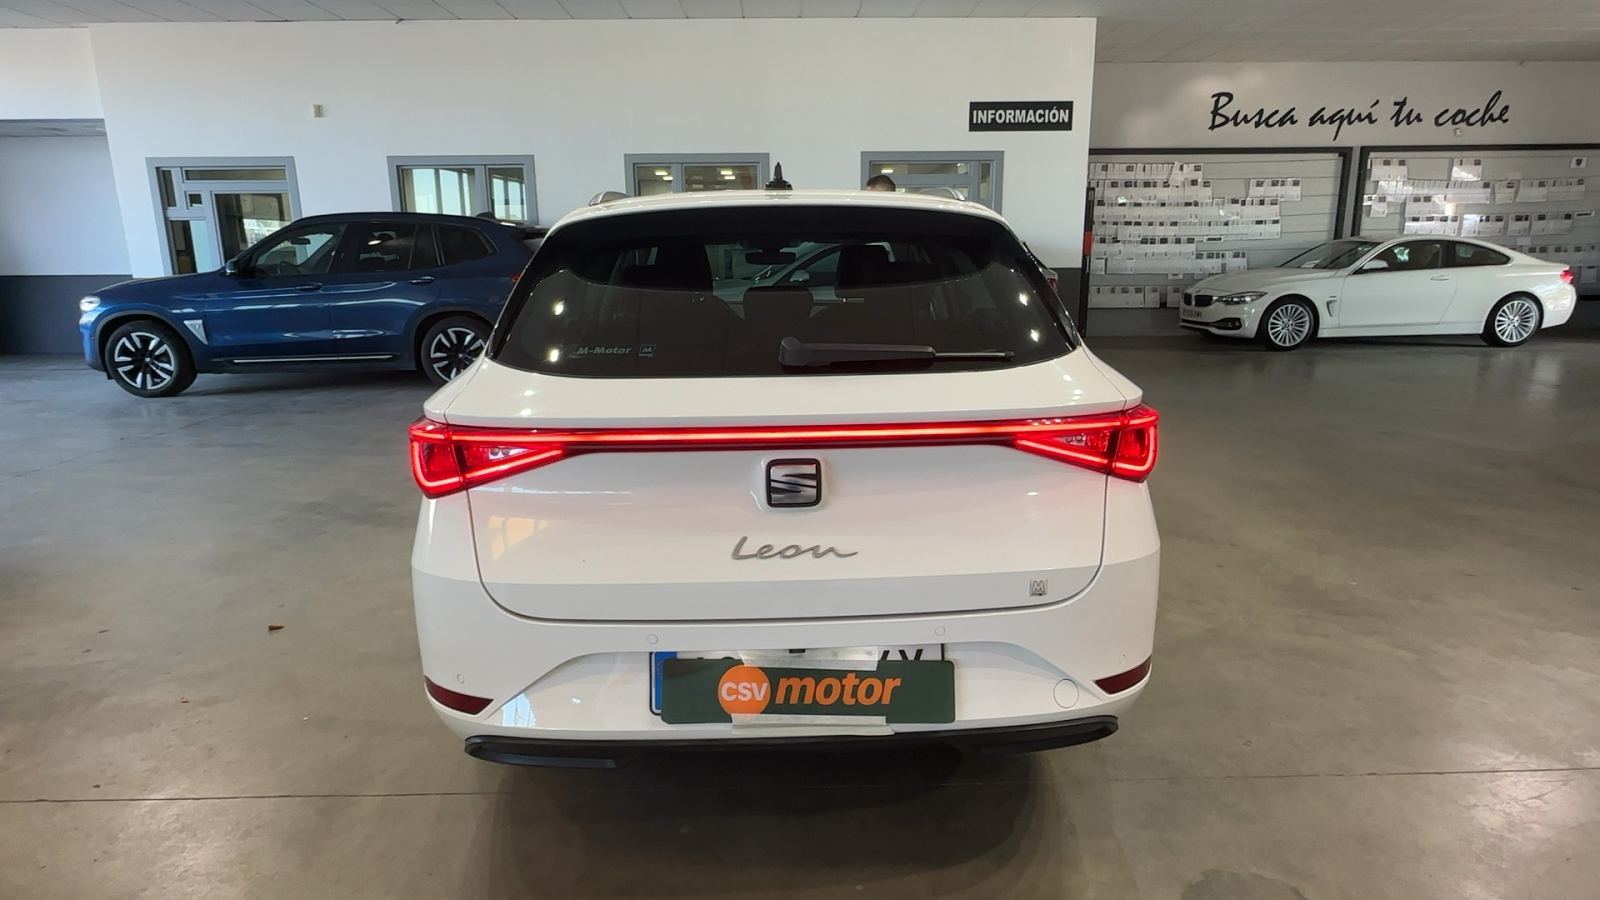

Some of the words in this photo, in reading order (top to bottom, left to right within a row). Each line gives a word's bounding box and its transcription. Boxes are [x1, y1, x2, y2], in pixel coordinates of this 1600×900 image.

[973, 106, 1069, 124] INFORMACIÓN
[1208, 91, 1298, 131] Busca
[1308, 99, 1379, 141] aquí
[1390, 96, 1423, 127] tu
[1434, 90, 1510, 127] coche
[577, 346, 632, 354] M-Motor
[731, 536, 858, 560] Leon
[775, 672, 902, 706] motor
